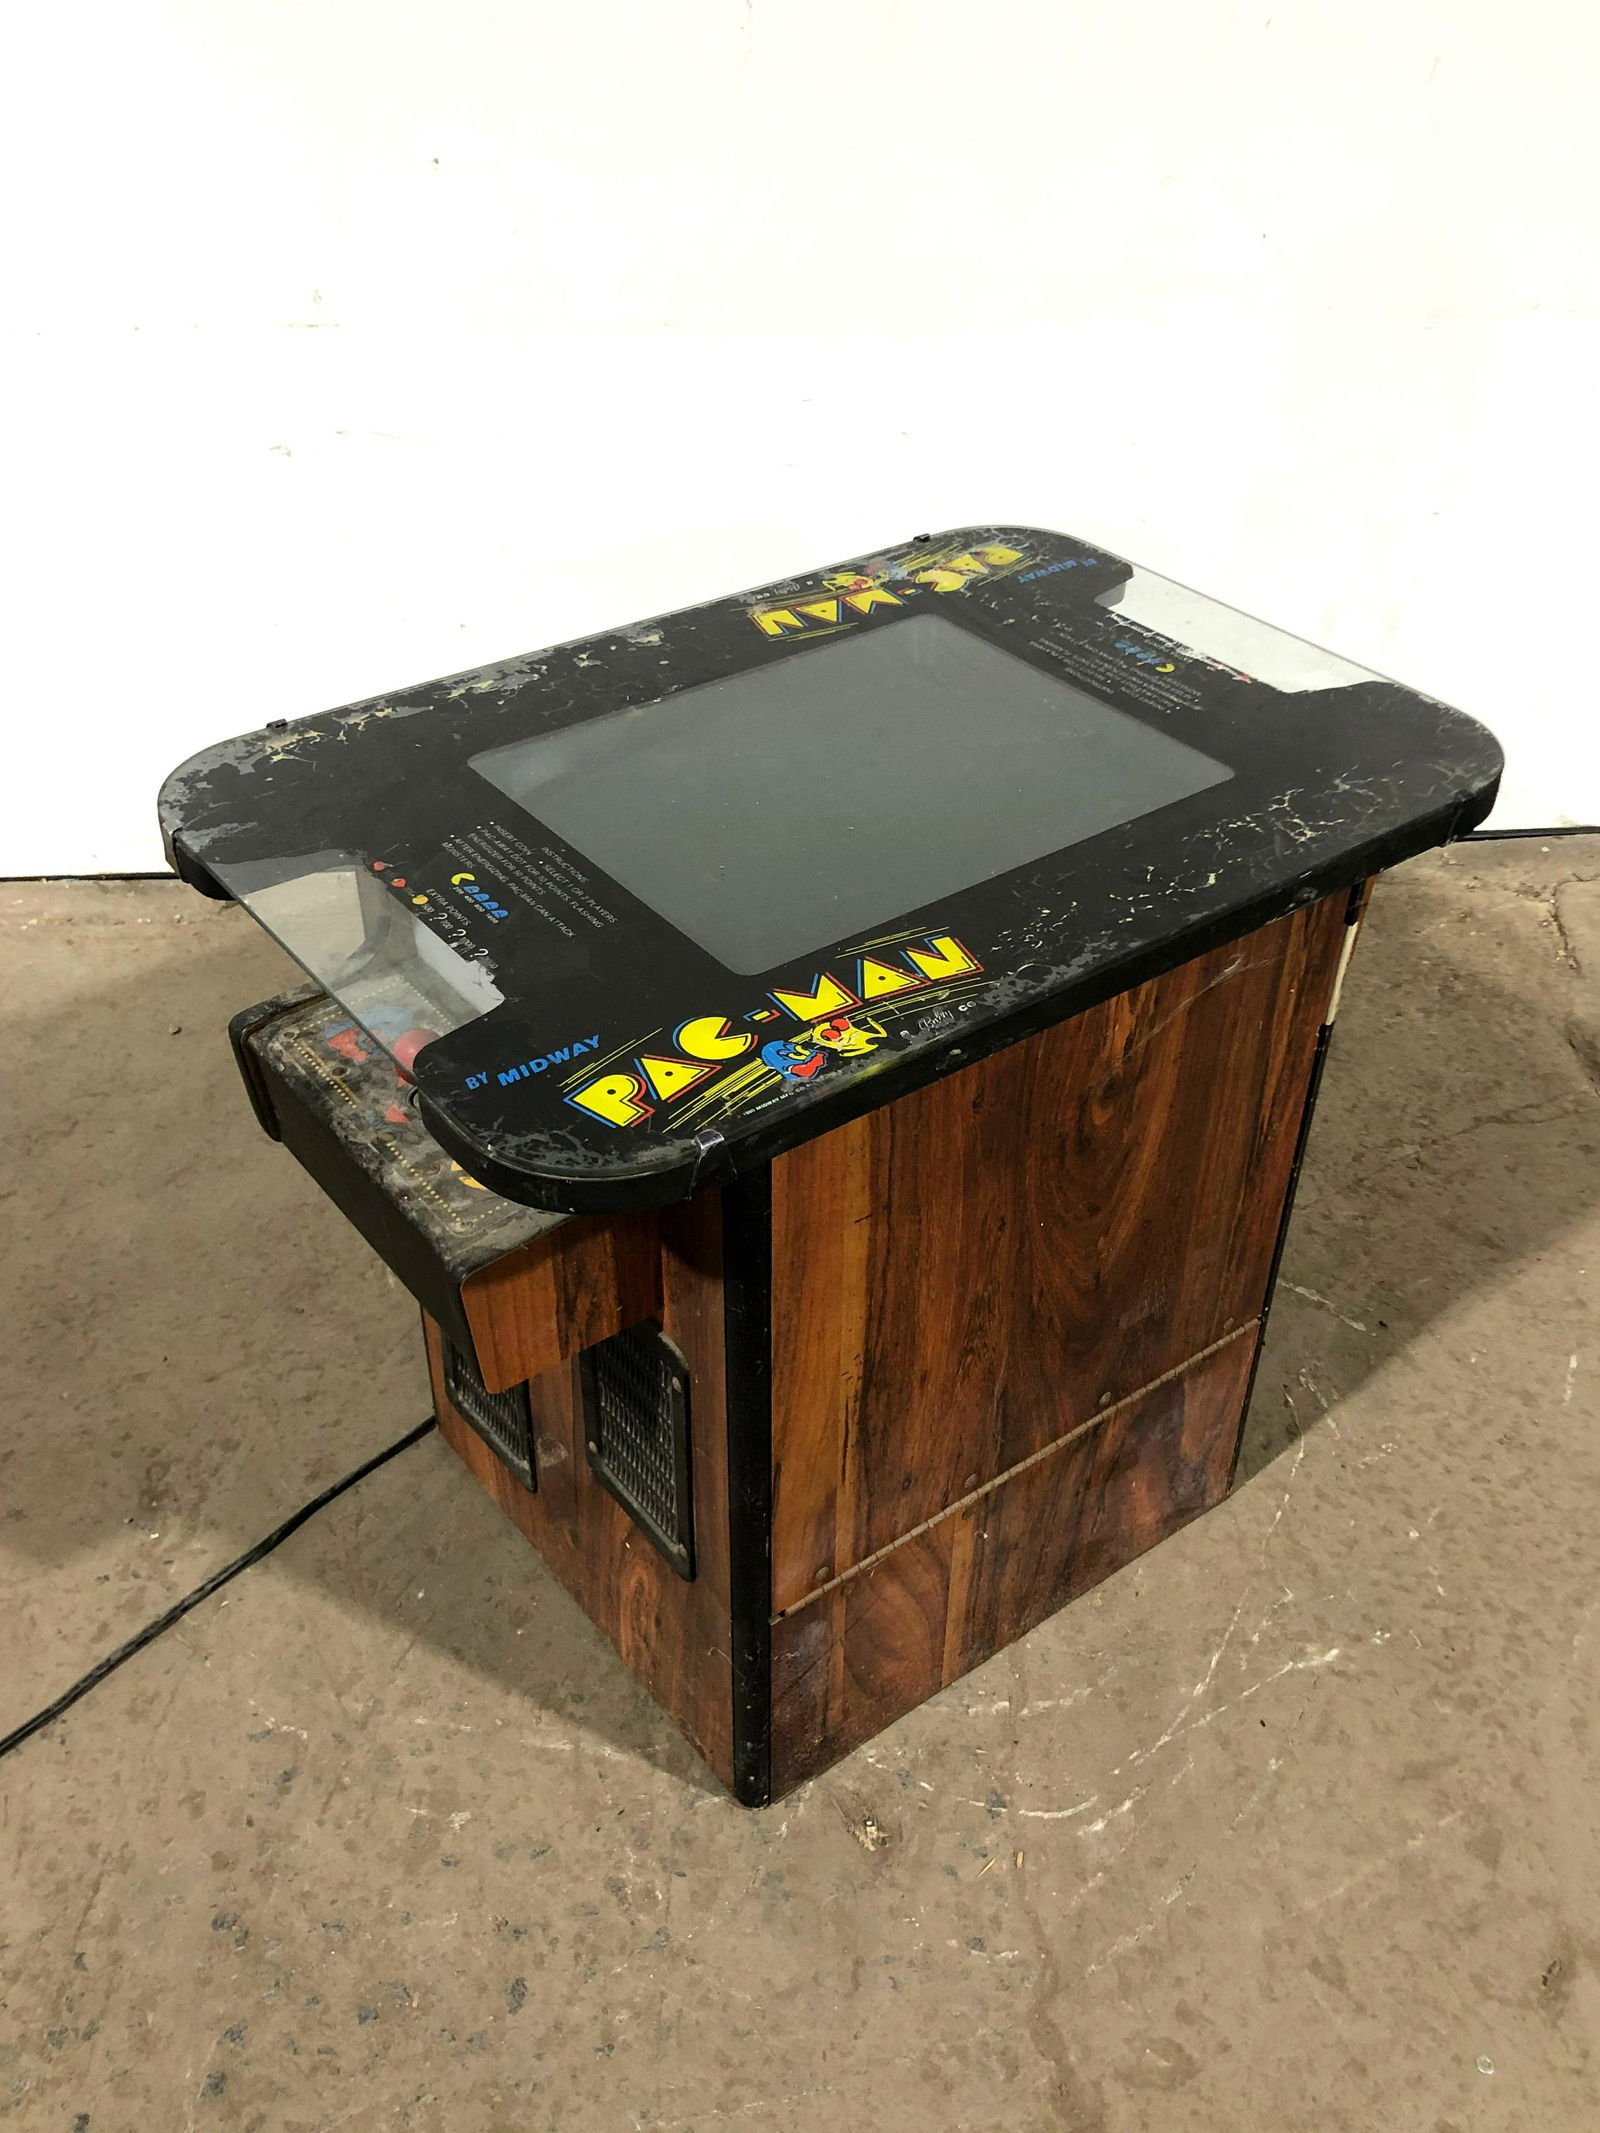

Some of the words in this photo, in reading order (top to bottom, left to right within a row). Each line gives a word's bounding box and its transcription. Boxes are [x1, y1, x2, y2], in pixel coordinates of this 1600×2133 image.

[749, 544, 1026, 637] PAC-MAN
[1017, 559, 1078, 584] MIDWAY
[467, 832, 504, 860] ENERGIZER
[500, 859, 517, 871] FOR
[493, 824, 518, 842] INSERT
[514, 841, 534, 856] COIN
[453, 838, 476, 853] AFTER
[534, 905, 551, 918] CAN
[547, 915, 577, 938] ATTACK
[541, 846, 589, 884] INSTRUCTIONS
[425, 888, 450, 907] EXTRA
[445, 905, 472, 926] POINTS
[524, 864, 540, 877] FOR
[570, 900, 605, 928] FLASHING
[543, 864, 570, 884] SELECT
[571, 887, 585, 897] OR
[586, 898, 619, 924] PLAYERS
[563, 935, 984, 1128] PAC-MAN
[465, 1071, 490, 1091] BY
[497, 1034, 601, 1087] MIDWAY
[755, 1097, 780, 1111] MIDWAY
